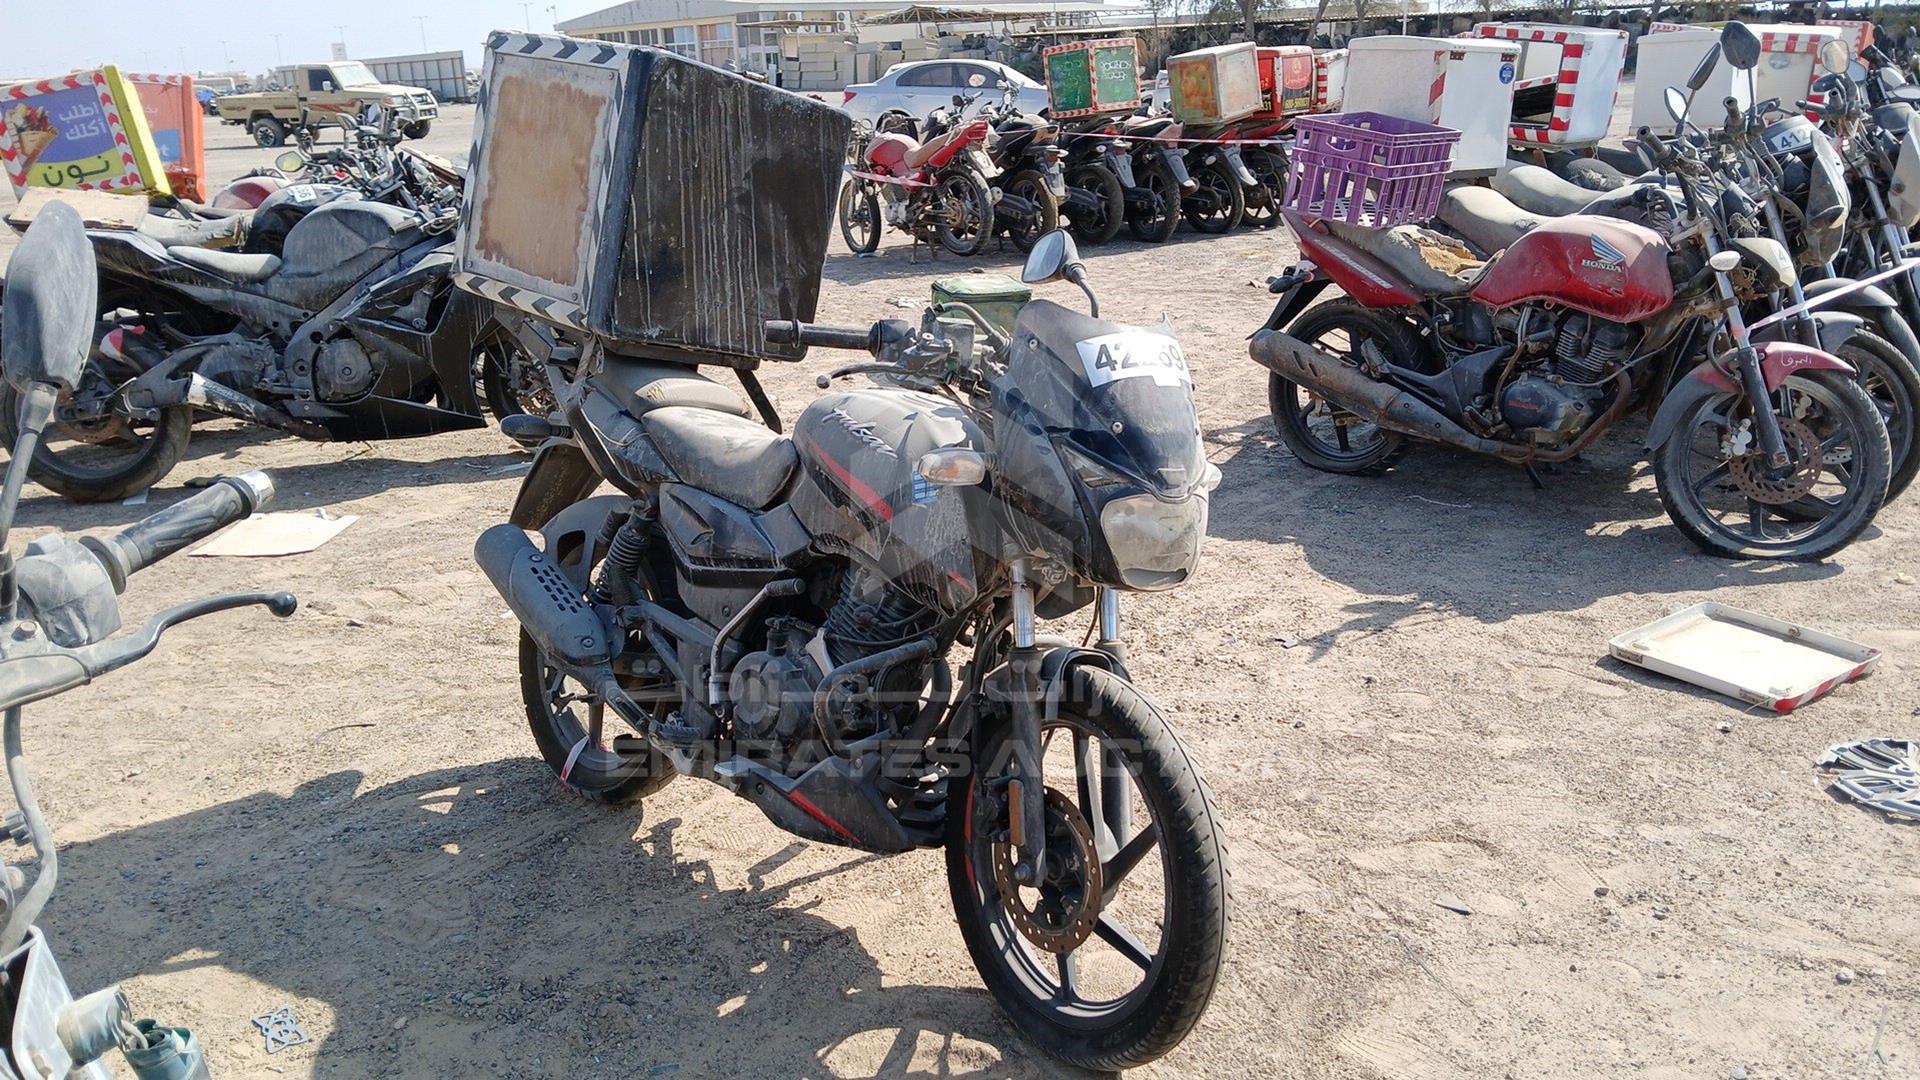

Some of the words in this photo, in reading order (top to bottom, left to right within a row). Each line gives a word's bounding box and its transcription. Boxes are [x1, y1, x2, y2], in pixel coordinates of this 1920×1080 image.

[59, 102, 99, 122] اطلب
[42, 155, 110, 188] نون
[1581, 258, 1623, 273] HONDA
[1095, 343, 1185, 372] 4269
